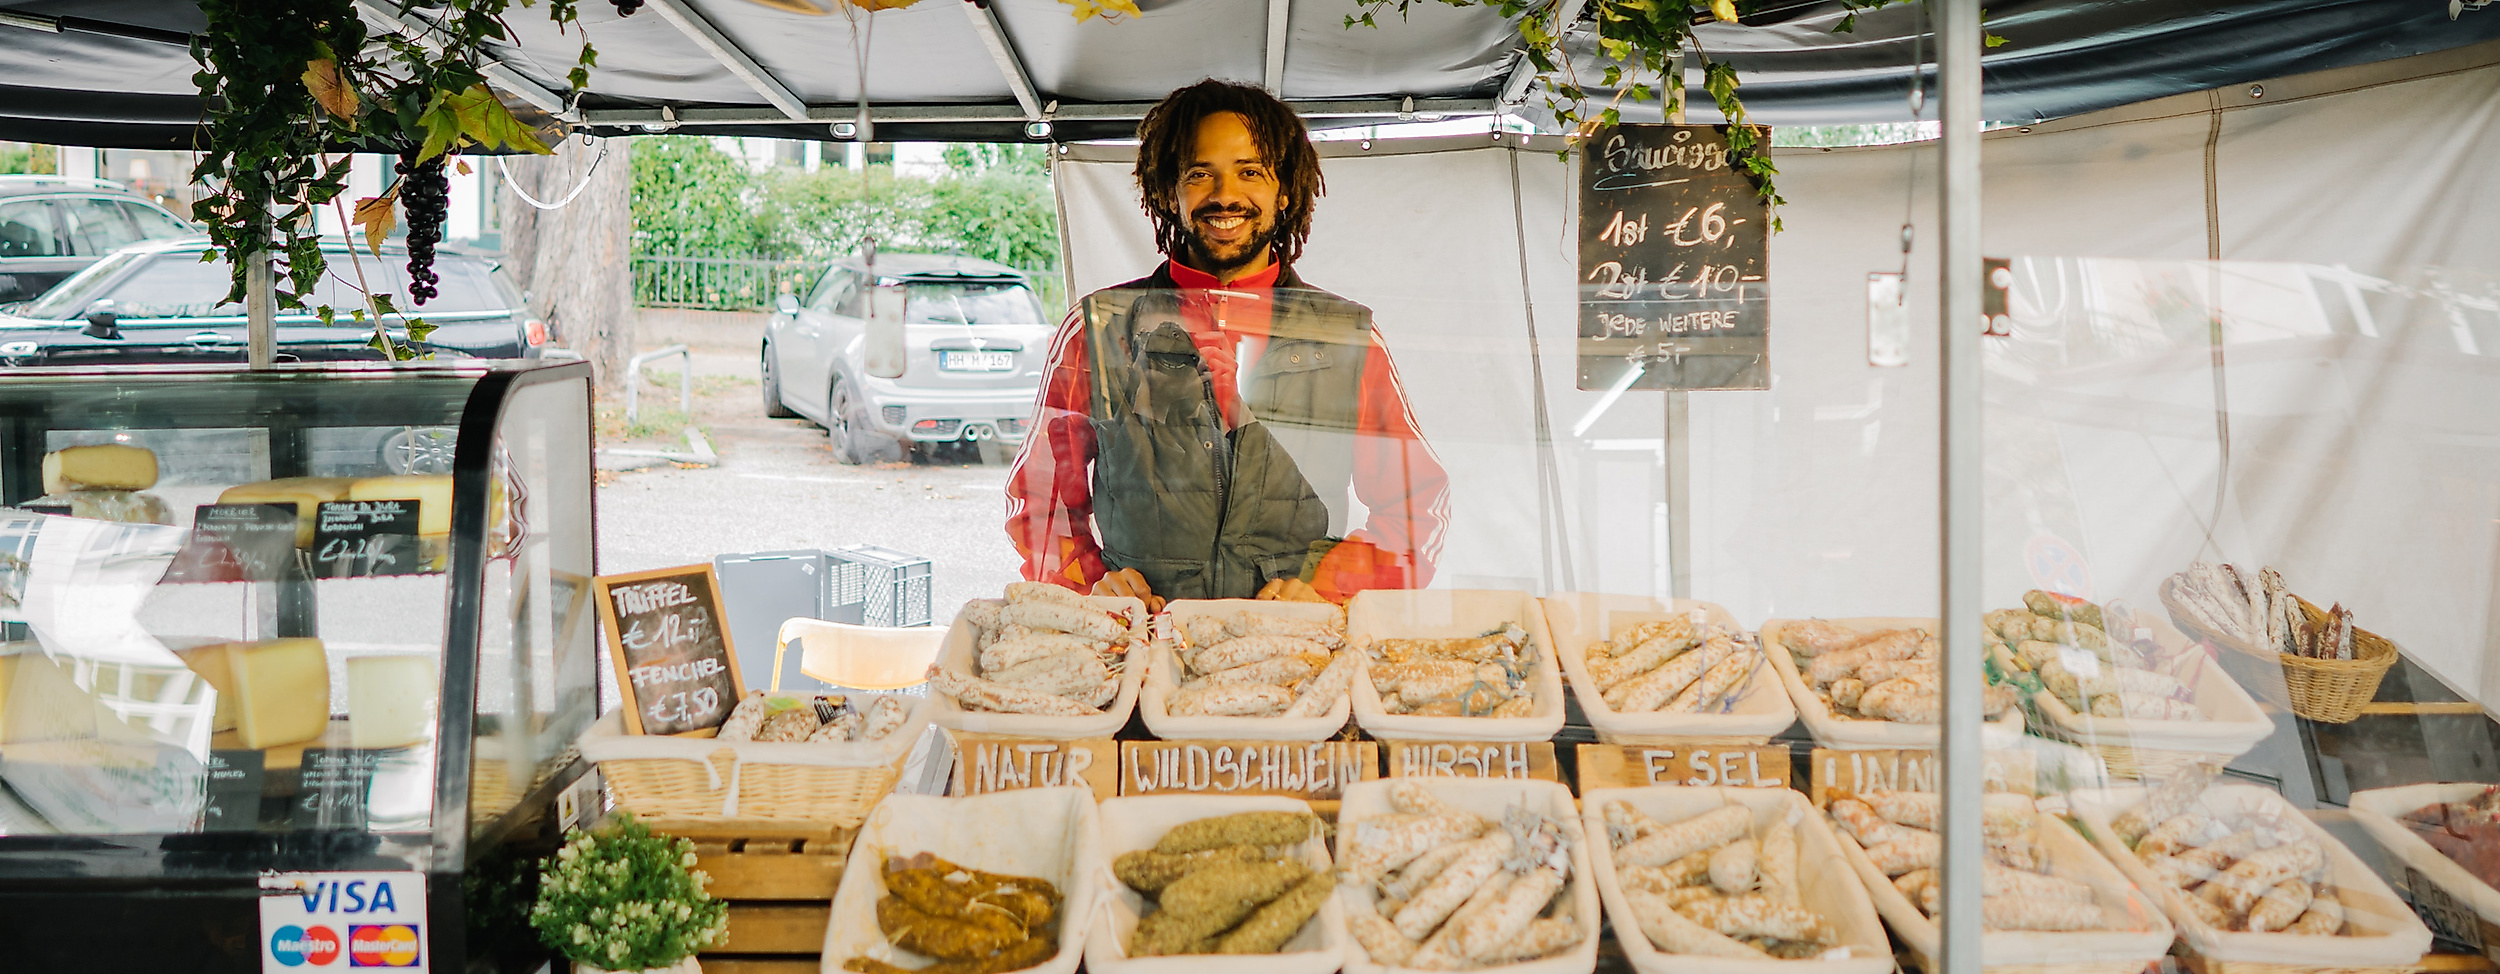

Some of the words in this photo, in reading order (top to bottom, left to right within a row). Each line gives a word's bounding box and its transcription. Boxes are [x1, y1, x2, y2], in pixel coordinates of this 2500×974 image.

[1658, 311, 1740, 333] WEITERE
[629, 658, 726, 688] FENCHEL
[974, 743, 1093, 795] NATUR
[1132, 743, 1361, 793] WILDSCHWEIN
[1402, 743, 1528, 779] HIRSCH
[303, 882, 396, 913] VISA
[277, 939, 337, 953] Maestro
[352, 938, 417, 953] MasterCard
